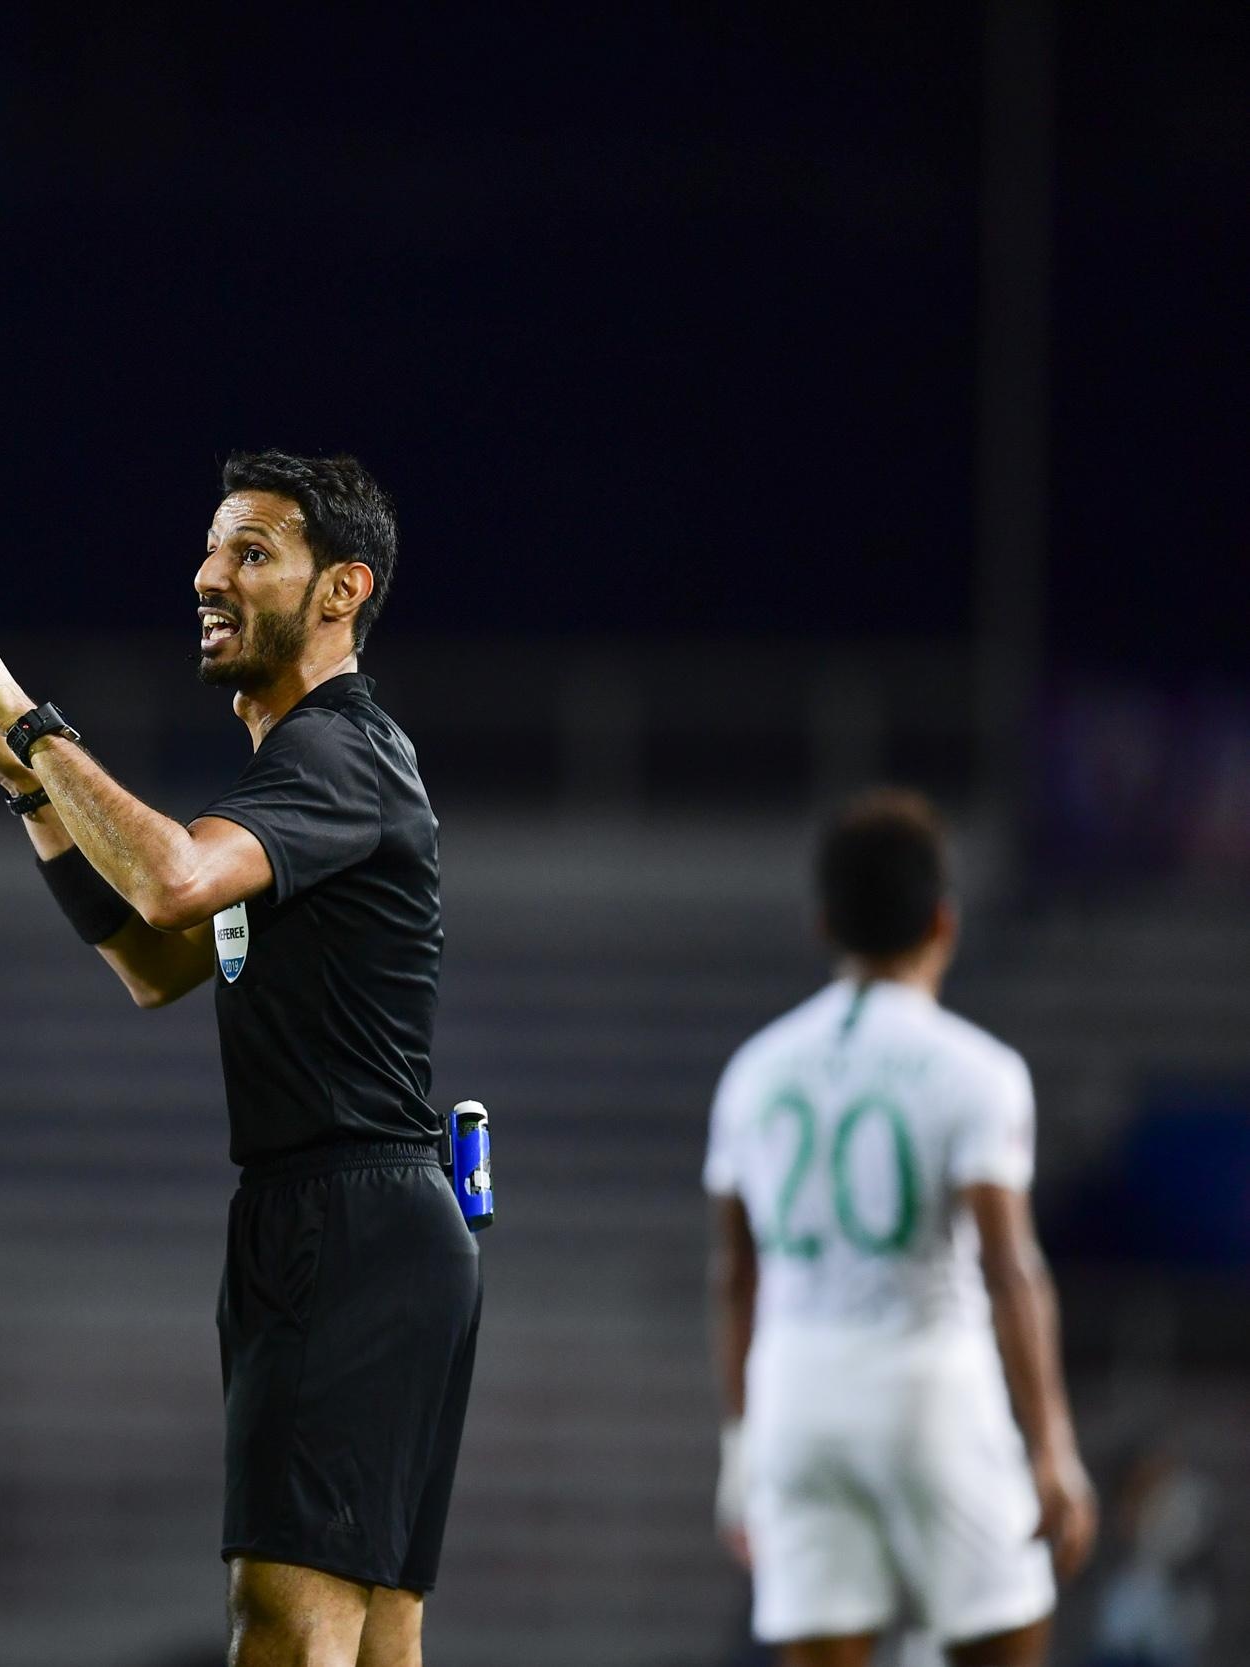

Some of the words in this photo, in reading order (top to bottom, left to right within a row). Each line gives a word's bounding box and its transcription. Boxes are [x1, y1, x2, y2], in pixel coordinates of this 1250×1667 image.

[217, 926, 245, 941] REFEREE
[225, 960, 239, 973] 2019
[758, 1086, 919, 1260] 20
